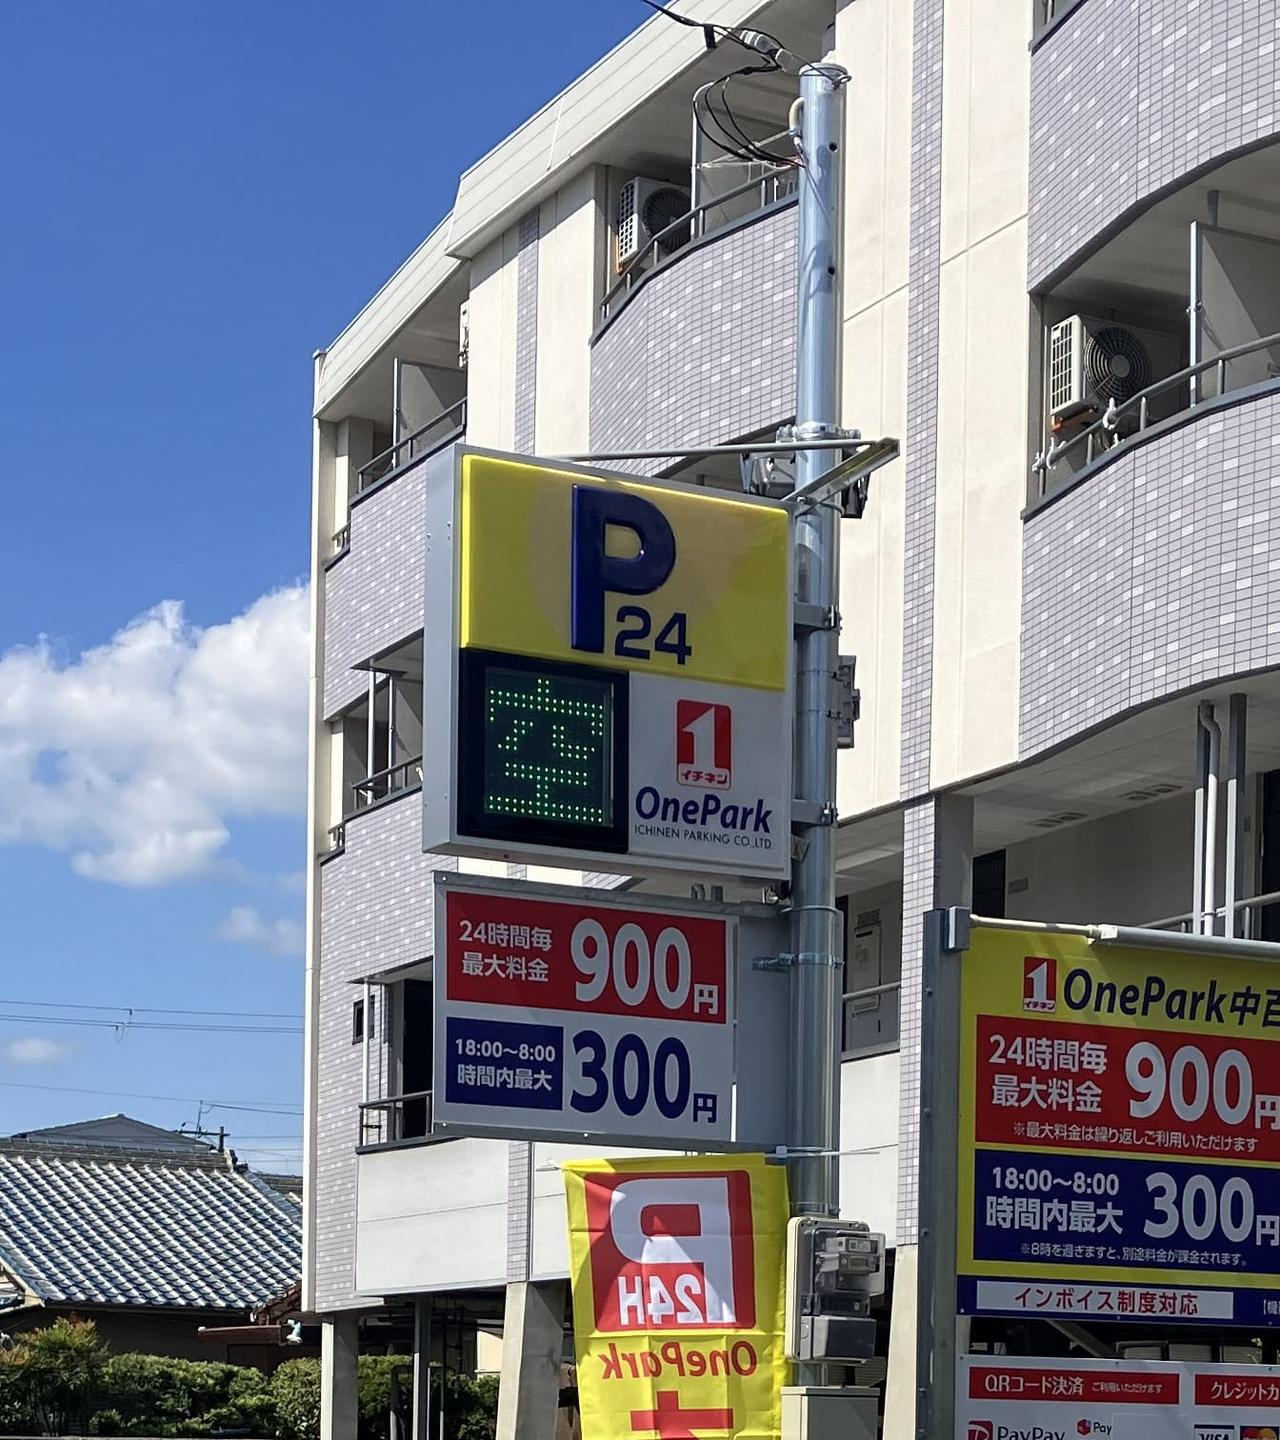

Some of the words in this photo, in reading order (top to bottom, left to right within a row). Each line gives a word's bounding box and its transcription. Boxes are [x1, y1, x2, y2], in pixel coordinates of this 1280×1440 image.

[572, 485, 676, 653] P
[615, 606, 692, 665] 24
[490, 678, 603, 823] 空
[680, 769, 728, 786] イチネン
[635, 786, 771, 833] OnePark
[634, 825, 681, 841] ICHINEN
[684, 829, 731, 845] PARKING
[459, 920, 552, 951] 24時間毎
[462, 953, 549, 982] 最大料金
[570, 918, 718, 1014] 900円
[989, 1034, 1107, 1074] 24時間毎
[457, 1065, 552, 1091] 時間内最大
[570, 1030, 717, 1122] 300円
[992, 1074, 1102, 1112] 最大料金
[1125, 1041, 1280, 1130] 900円
[986, 1196, 1123, 1235] 時間内最大
[1143, 1172, 1279, 1246] 300円
[1015, 1287, 1198, 1315] インボイス制度対応
[984, 1374, 1084, 1396] QRコード決済
[1093, 1421, 1112, 1435] Pay
